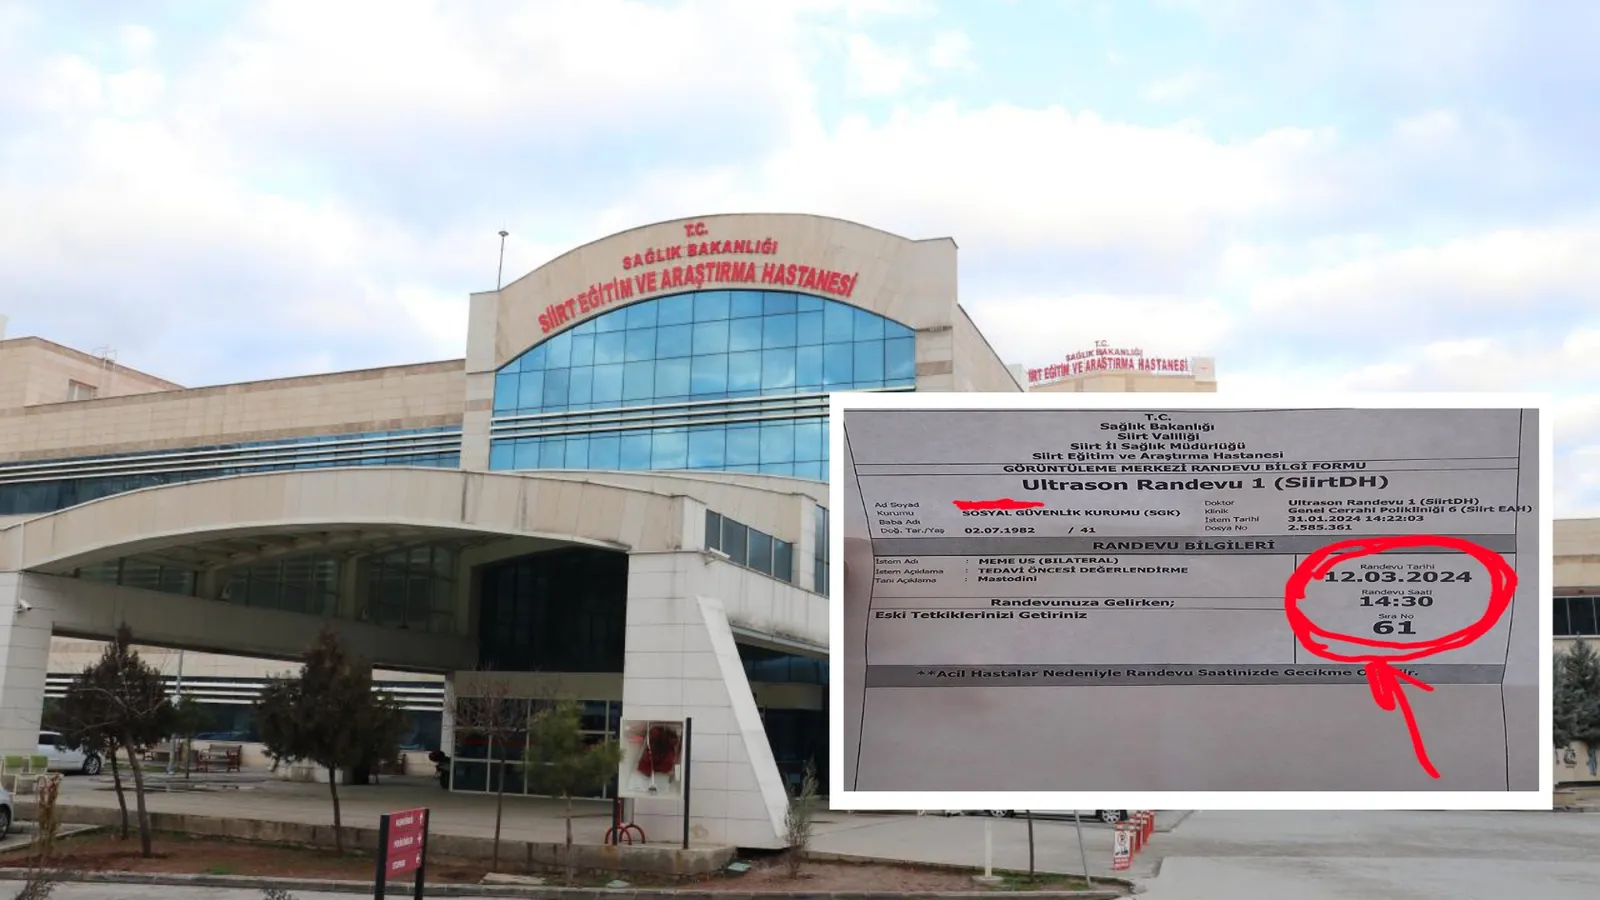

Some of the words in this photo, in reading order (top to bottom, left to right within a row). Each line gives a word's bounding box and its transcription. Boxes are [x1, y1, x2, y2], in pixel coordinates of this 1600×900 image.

[684, 222, 708, 237] T.C.
[622, 243, 681, 270] SAĞLIK
[687, 237, 778, 257] BAKANLIĞI
[577, 276, 634, 313] EĞİTİM
[635, 271, 657, 294] VE
[660, 261, 757, 289] ARAŞTIRMA
[761, 262, 859, 298] HASTANESİ
[1072, 360, 1083, 374] VE
[1085, 356, 1135, 372] ARAŞTIRMA
[1138, 356, 1189, 371] HASTANESİ
[1144, 413, 1172, 421] T.C.
[1100, 422, 1146, 432] Sağlık
[1150, 422, 1215, 432] Bakanlığı
[1117, 432, 1149, 441] Siirt
[1152, 432, 1200, 442] Valiliği
[1070, 442, 1102, 451] Siirt
[1105, 440, 1117, 450] İl
[1121, 441, 1165, 452] Sağlık
[1170, 441, 1246, 451] Müdürlüğü
[1032, 452, 1063, 460] Siirt
[1068, 452, 1115, 462] Eğitim
[1140, 452, 1209, 462] Araştırma
[1213, 451, 1284, 460] Hastanesi
[1003, 463, 1117, 473] GÖRÜNTÜLEME
[1121, 463, 1187, 473] MERKEZİ
[1191, 463, 1261, 472] RANDEVU
[1265, 461, 1307, 471] BİLGİ
[1312, 461, 1367, 471] FORMU
[1022, 478, 1128, 491] Ultrason
[1137, 478, 1243, 491] Randevu
[1252, 477, 1265, 489] 1
[1274, 475, 1389, 491] (SiirtDH)
[890, 501, 920, 509] Soyad
[1420, 498, 1480, 506] (SiirtDH)
[1144, 509, 1181, 517] (SGK)
[1380, 506, 1445, 514] Polikliniği
[1460, 505, 1495, 514] (Siirt
[1498, 505, 1533, 514] EAH)
[1093, 541, 1179, 550] RANDEVU
[1185, 539, 1275, 550] BİLGİLERİ
[1028, 566, 1076, 574] ÖNCESİ
[1080, 566, 1188, 574] DEĞERLENDİRME
[1325, 571, 1472, 583] 12.03.2024
[990, 598, 1100, 607] Randevunuza
[1104, 597, 1175, 608] Gelirken;
[1359, 596, 1434, 607] 14:30
[875, 610, 907, 619] Eski
[911, 610, 1014, 619] Tetkiklerinizi
[1018, 610, 1088, 619] Getiriniz
[1372, 621, 1416, 635] 61
[970, 668, 1039, 677] Hastalar
[1043, 668, 1122, 679] Nedeniyle
[1126, 668, 1194, 677] Randevu
[1197, 668, 1280, 677] Saatinizde
[1284, 667, 1353, 676] Gecikme
